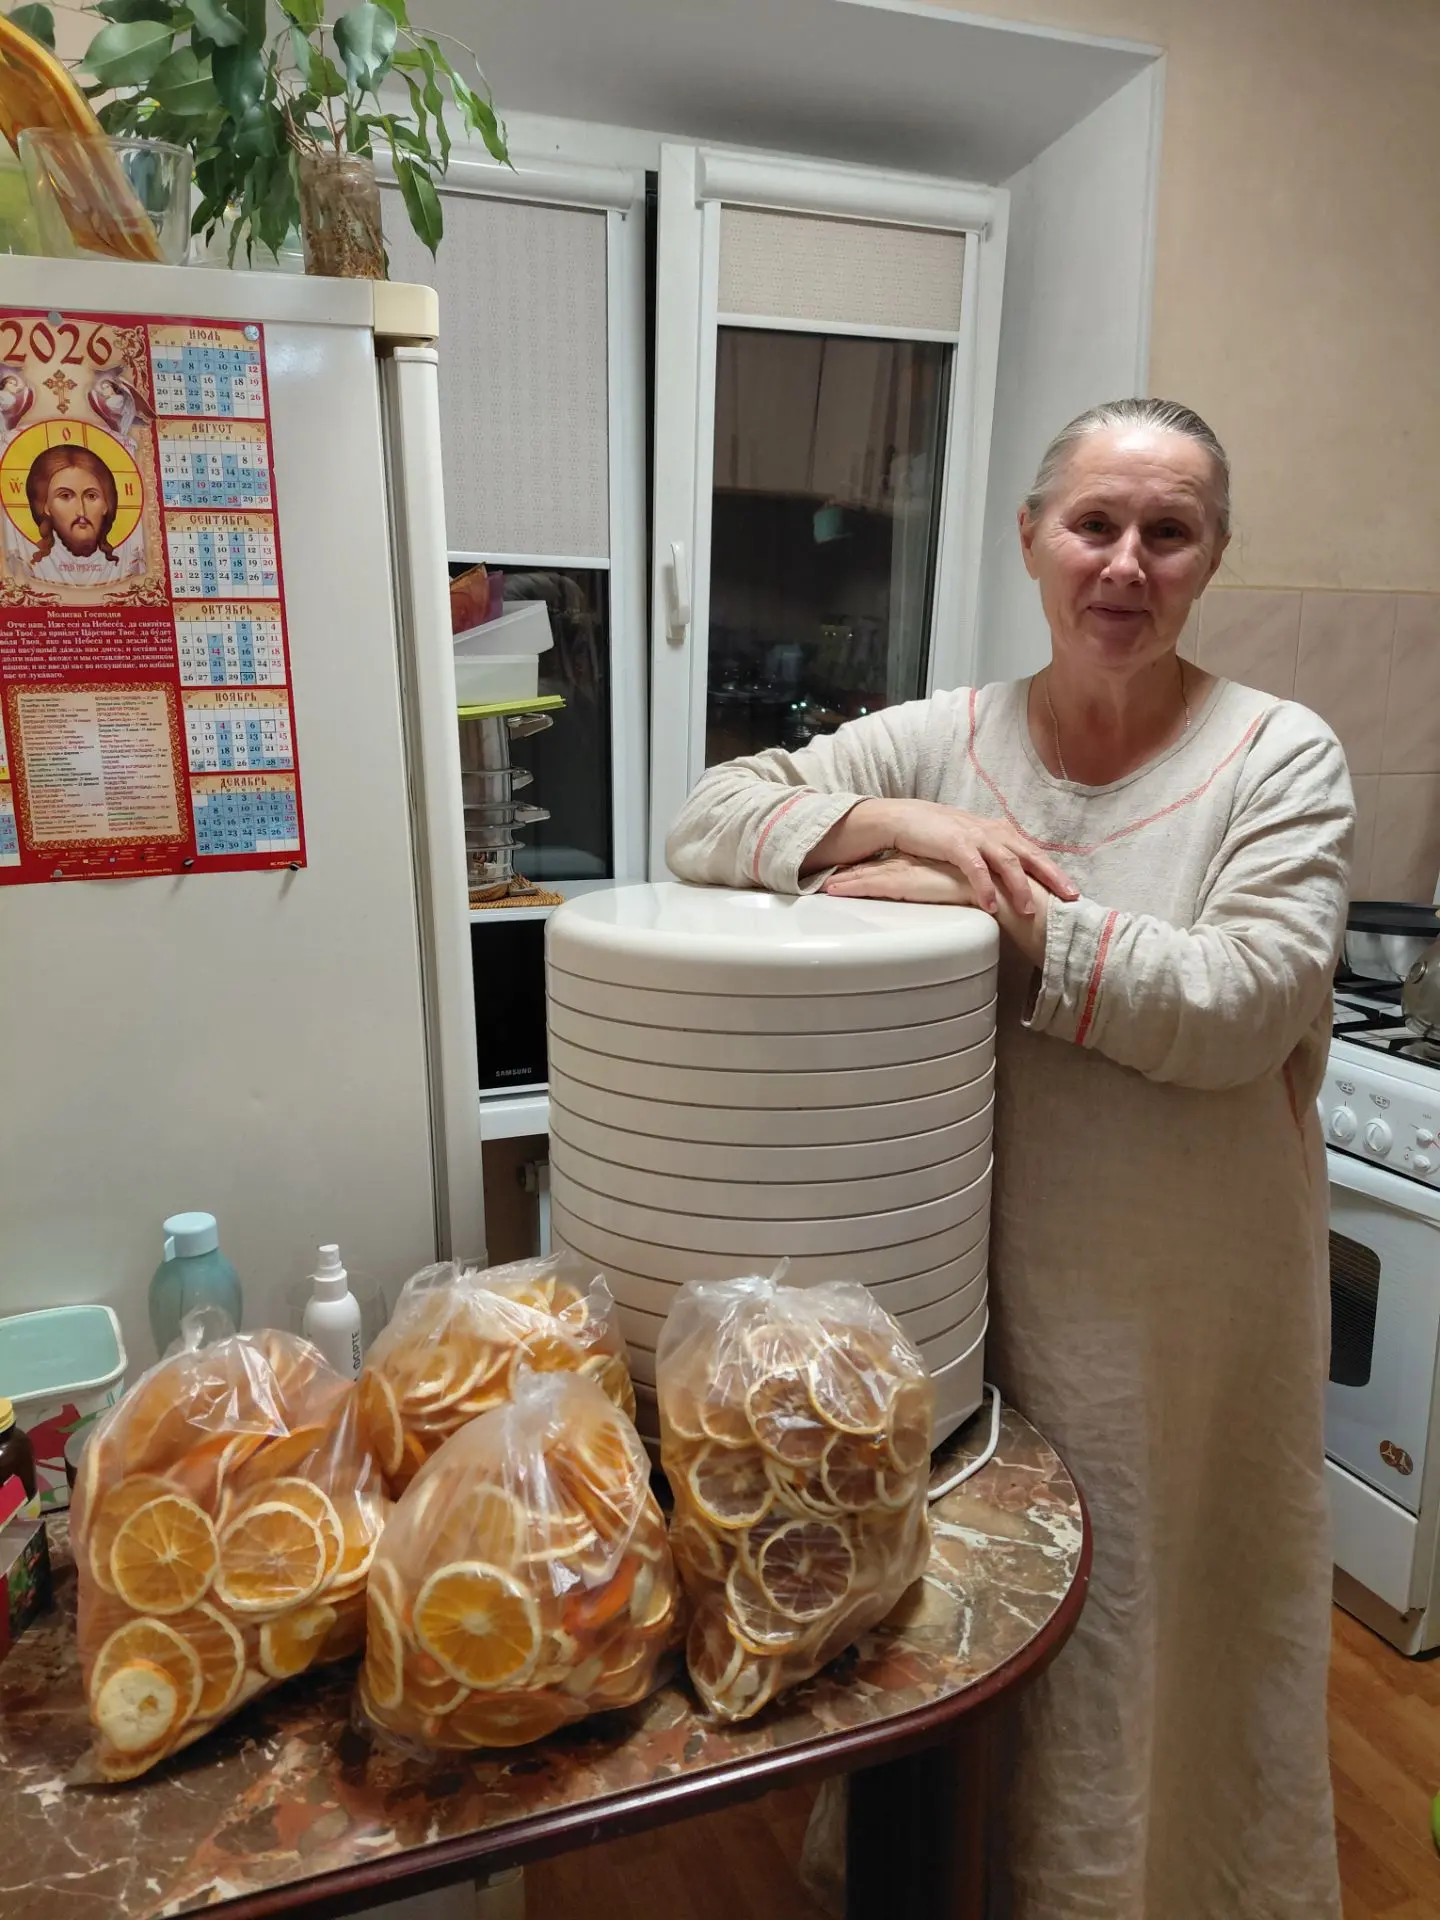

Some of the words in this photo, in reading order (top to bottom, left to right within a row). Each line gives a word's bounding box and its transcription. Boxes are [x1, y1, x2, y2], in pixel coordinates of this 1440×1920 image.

[0, 321, 112, 365] 2026
[173, 374, 182, 382] 14
[188, 375, 197, 383] 15
[235, 378, 243, 386] 18
[212, 468, 220, 476] 13
[190, 515, 249, 525] СЕНТЯБРЬ
[202, 605, 252, 614] ОКТЯБРЬ
[216, 692, 257, 701] НОЯБРЬ
[495, 1067, 532, 1077] SAMSUNG
